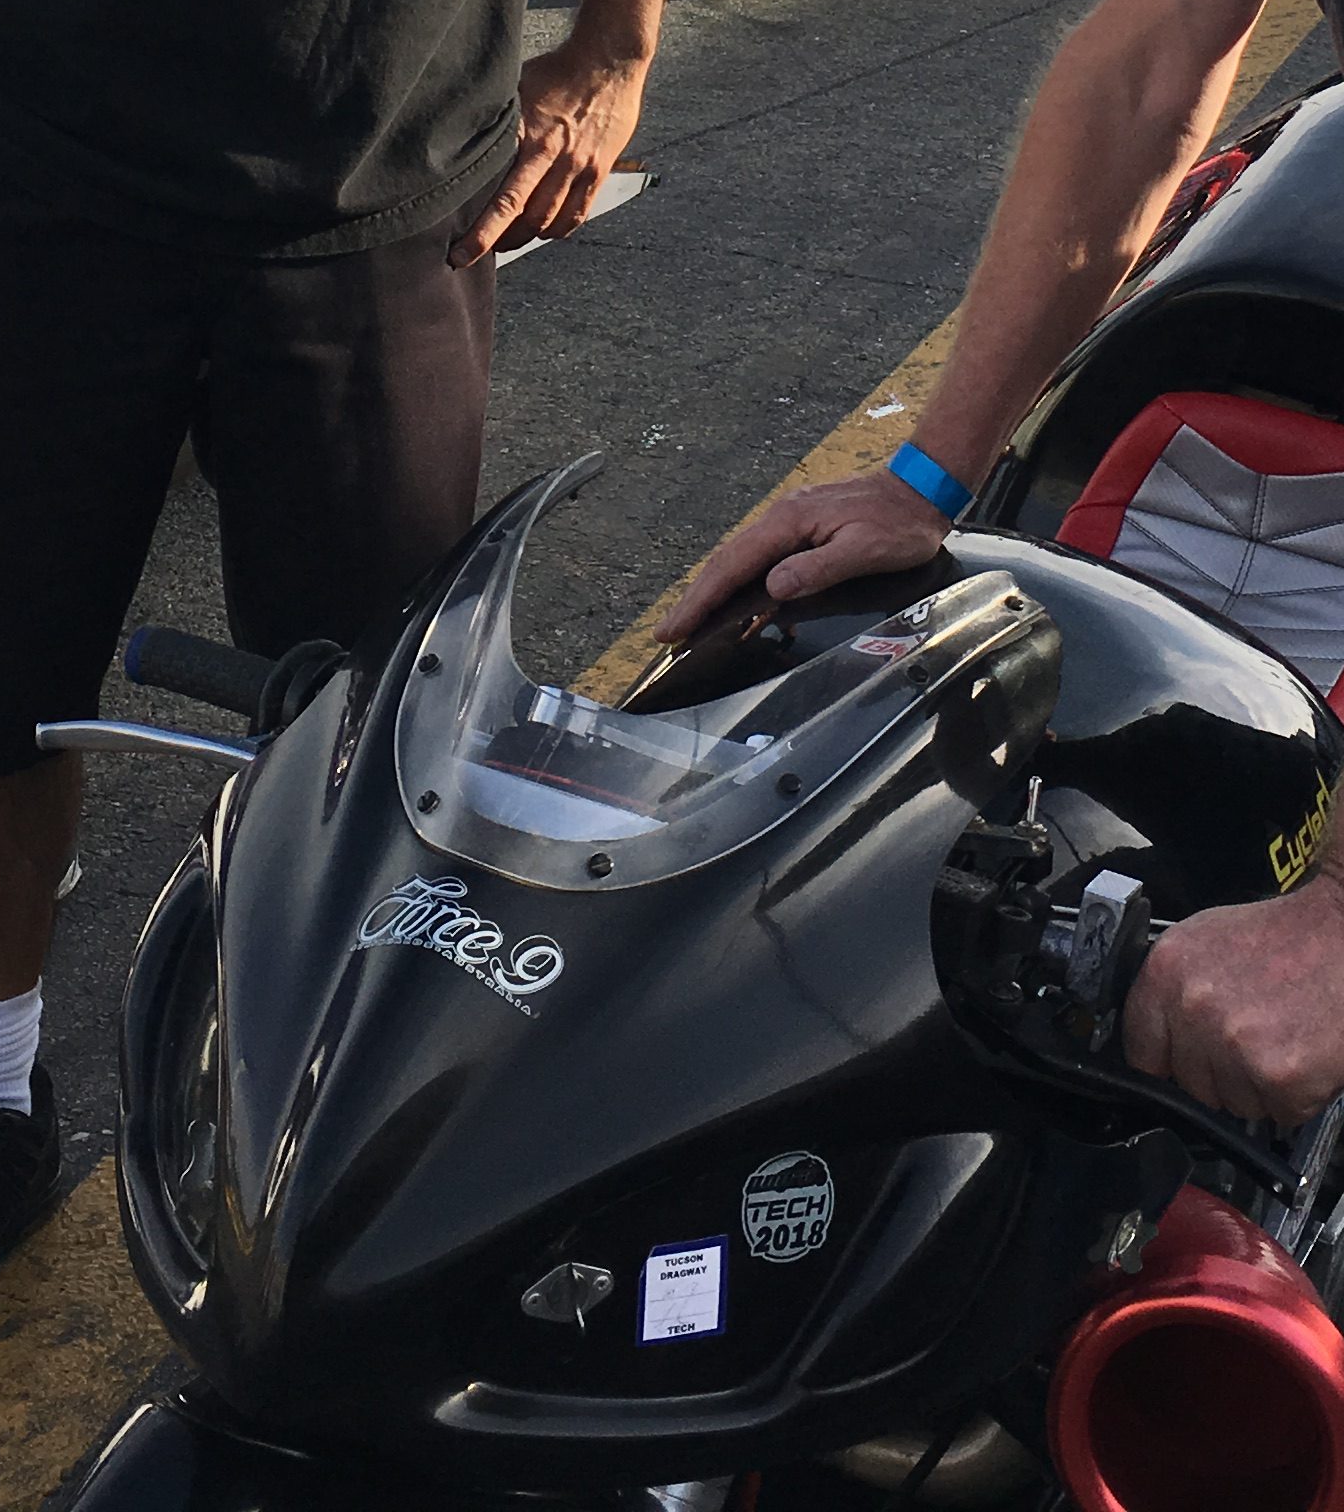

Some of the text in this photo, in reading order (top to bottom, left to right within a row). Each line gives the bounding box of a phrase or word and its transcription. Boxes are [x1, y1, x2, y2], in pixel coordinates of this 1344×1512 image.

[356, 873, 565, 995] Force 9
[747, 1194, 827, 1223] TECH
[753, 1219, 827, 1254] 2018
[664, 1253, 705, 1267] TUCSON
[659, 1265, 708, 1281] DRAGWAY
[666, 1322, 696, 1335] TECH
